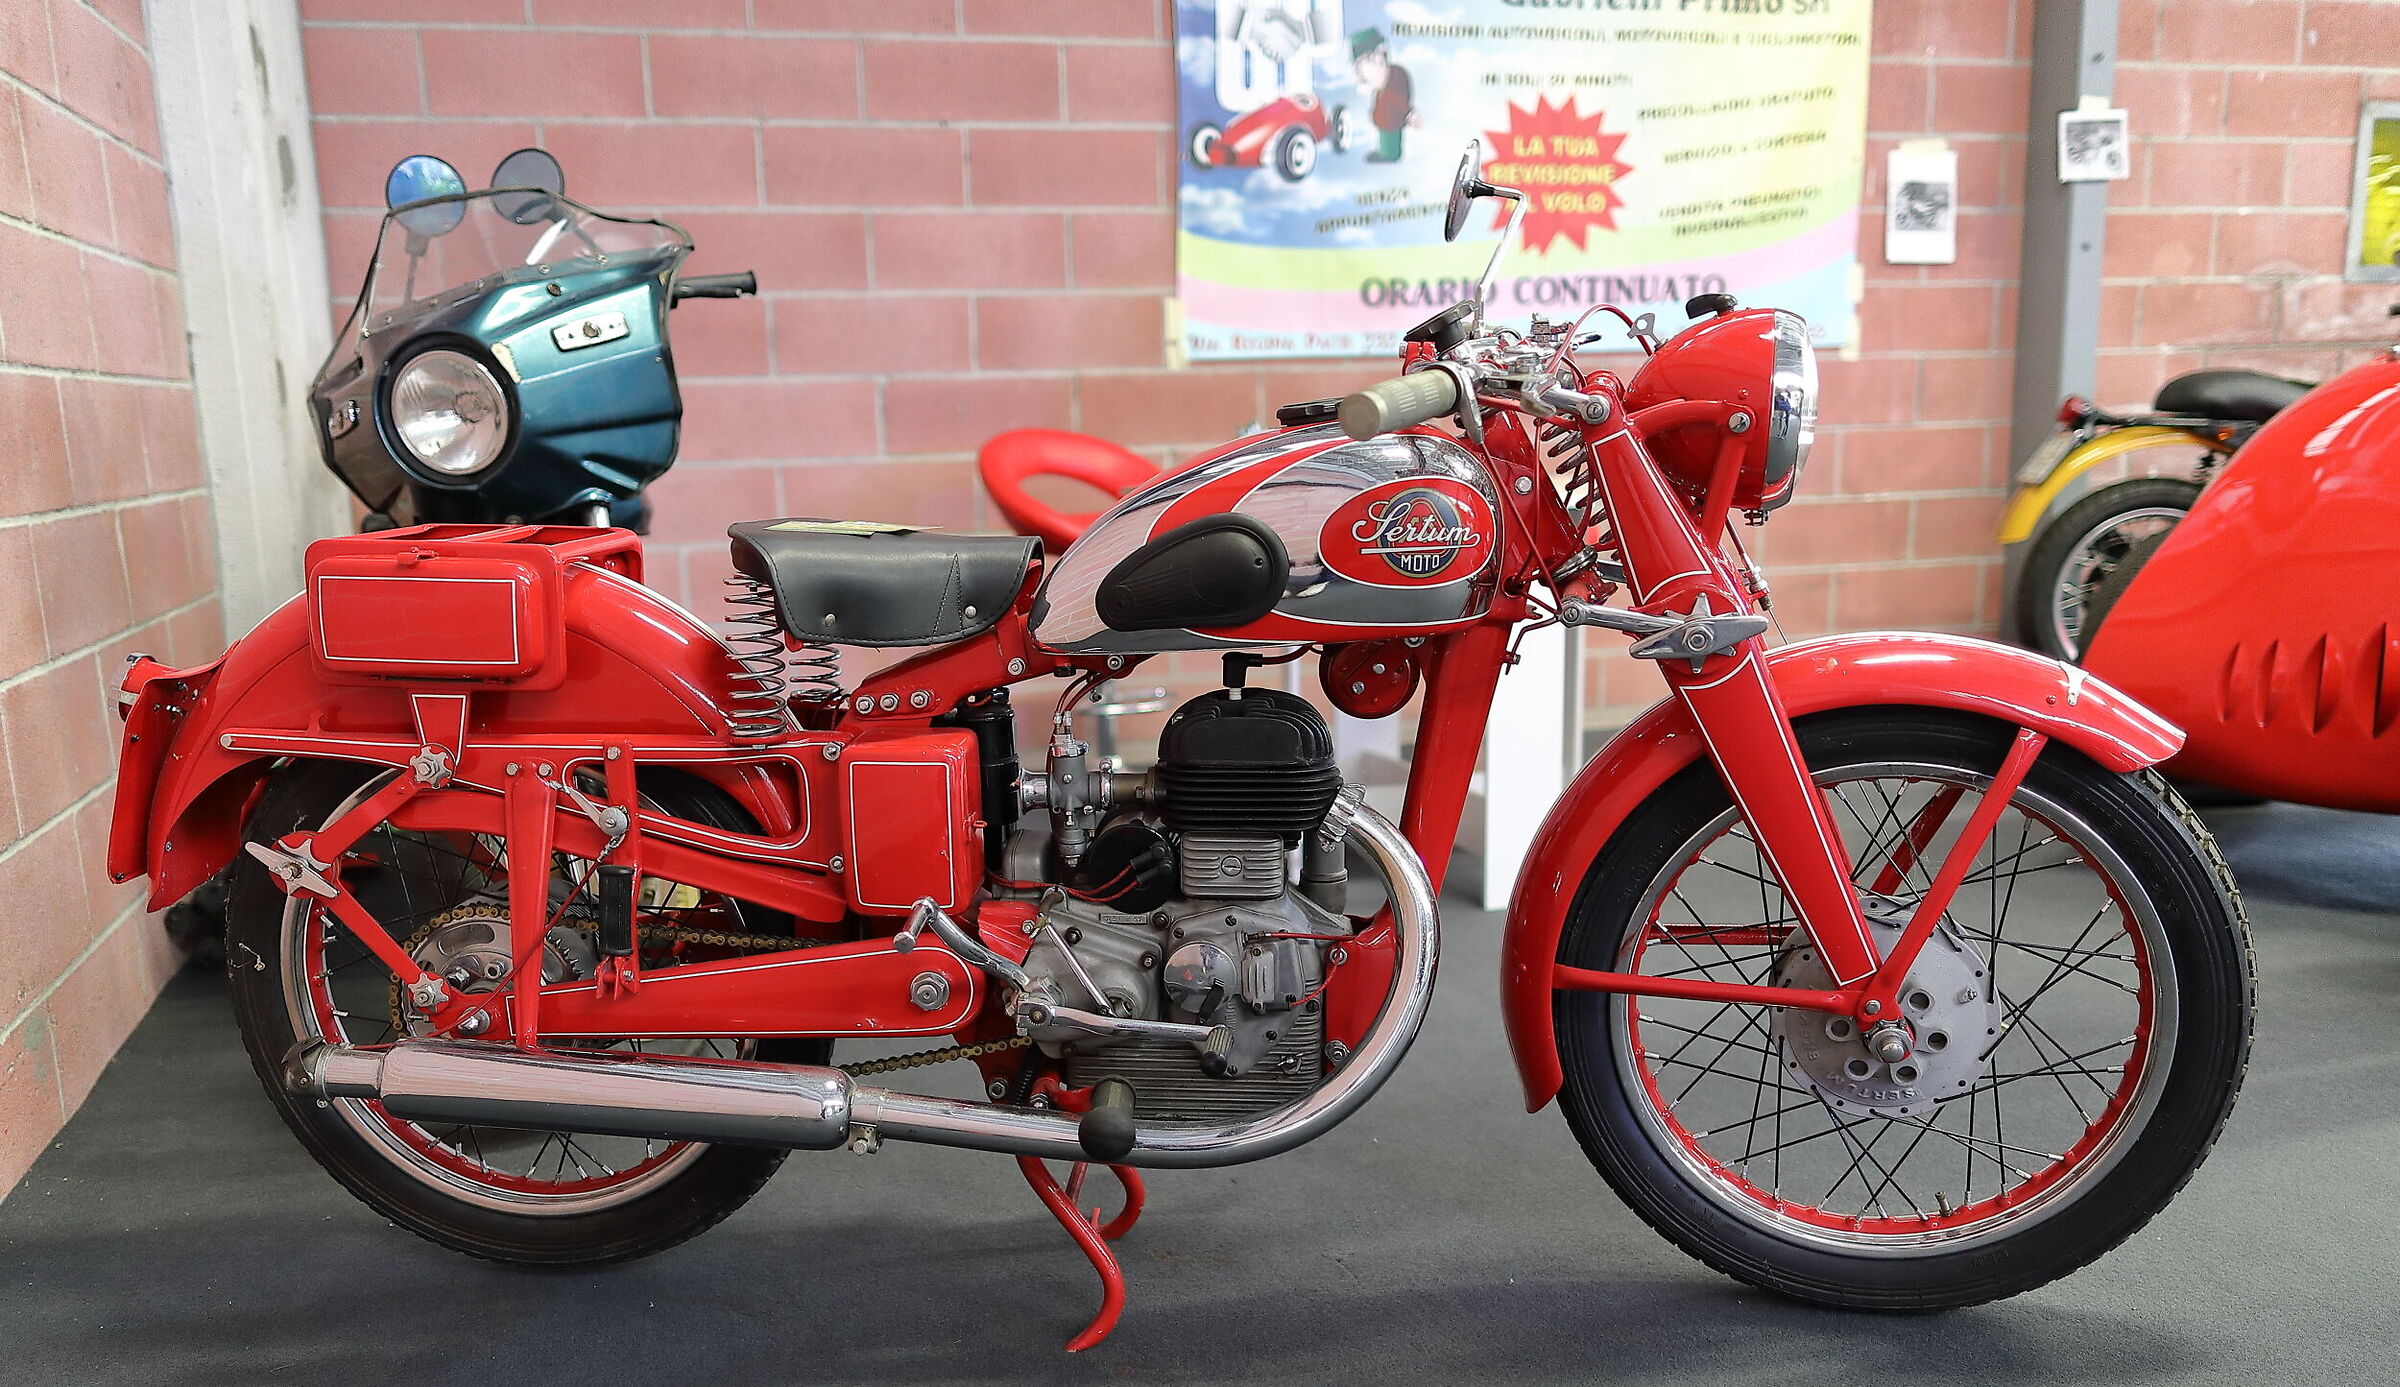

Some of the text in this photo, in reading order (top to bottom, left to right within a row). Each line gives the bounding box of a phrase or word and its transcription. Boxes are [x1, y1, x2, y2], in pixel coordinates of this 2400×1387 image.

[1513, 135, 1599, 157] LA TUA
[1488, 163, 1616, 186] REVISIONE
[1541, 191, 1607, 213] VOLO
[1360, 273, 1726, 308] ORARIO CONTINUATO
[1352, 501, 1481, 552] Sertum
[1400, 554, 1440, 572] MOTO
